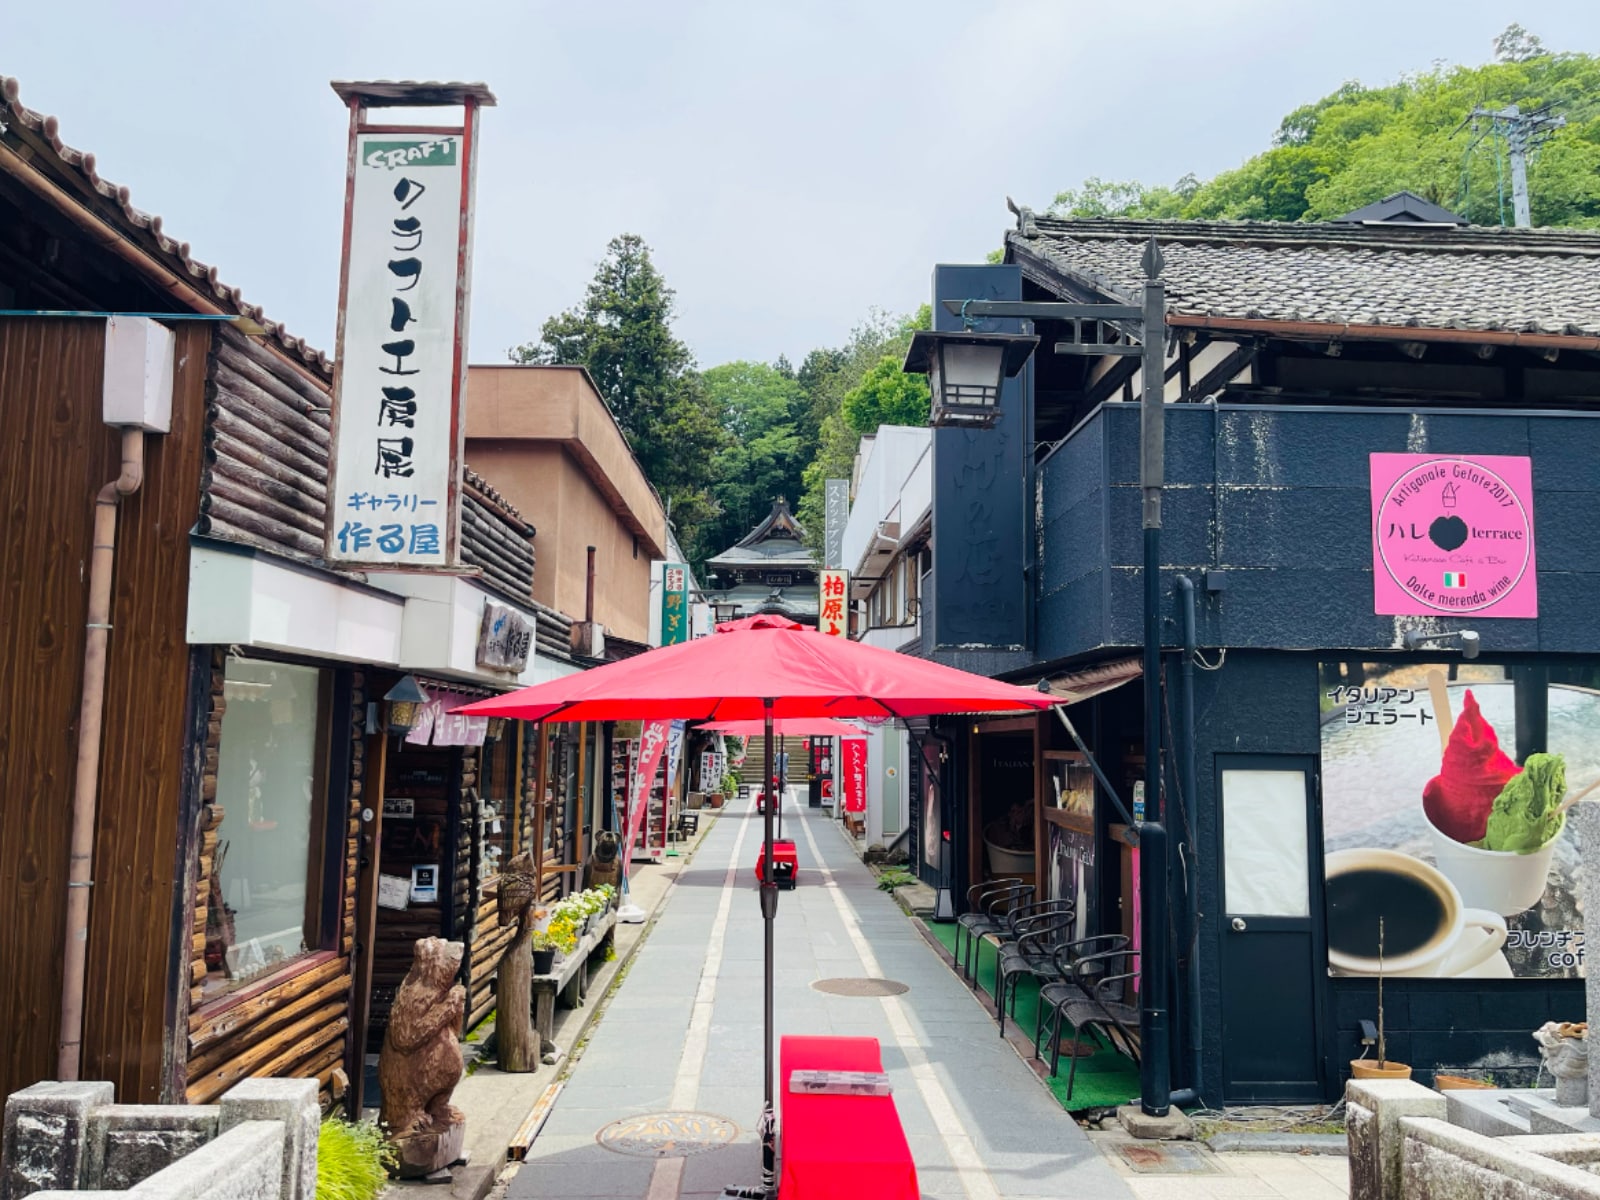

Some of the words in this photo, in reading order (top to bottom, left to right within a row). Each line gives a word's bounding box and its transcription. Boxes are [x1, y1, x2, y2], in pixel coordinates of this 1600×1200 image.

[366, 138, 454, 170] CRAFT
[346, 491, 438, 513] ギャラリー
[1391, 466, 1446, 507] Artiganale
[337, 521, 441, 555] 作る屋
[1388, 523, 1425, 540] ハレ
[1472, 527, 1522, 540] terrace
[1406, 575, 1436, 601] Dolce
[1438, 591, 1487, 606] merenda
[1488, 575, 1511, 597] wine
[1326, 685, 1415, 705] イタリアン
